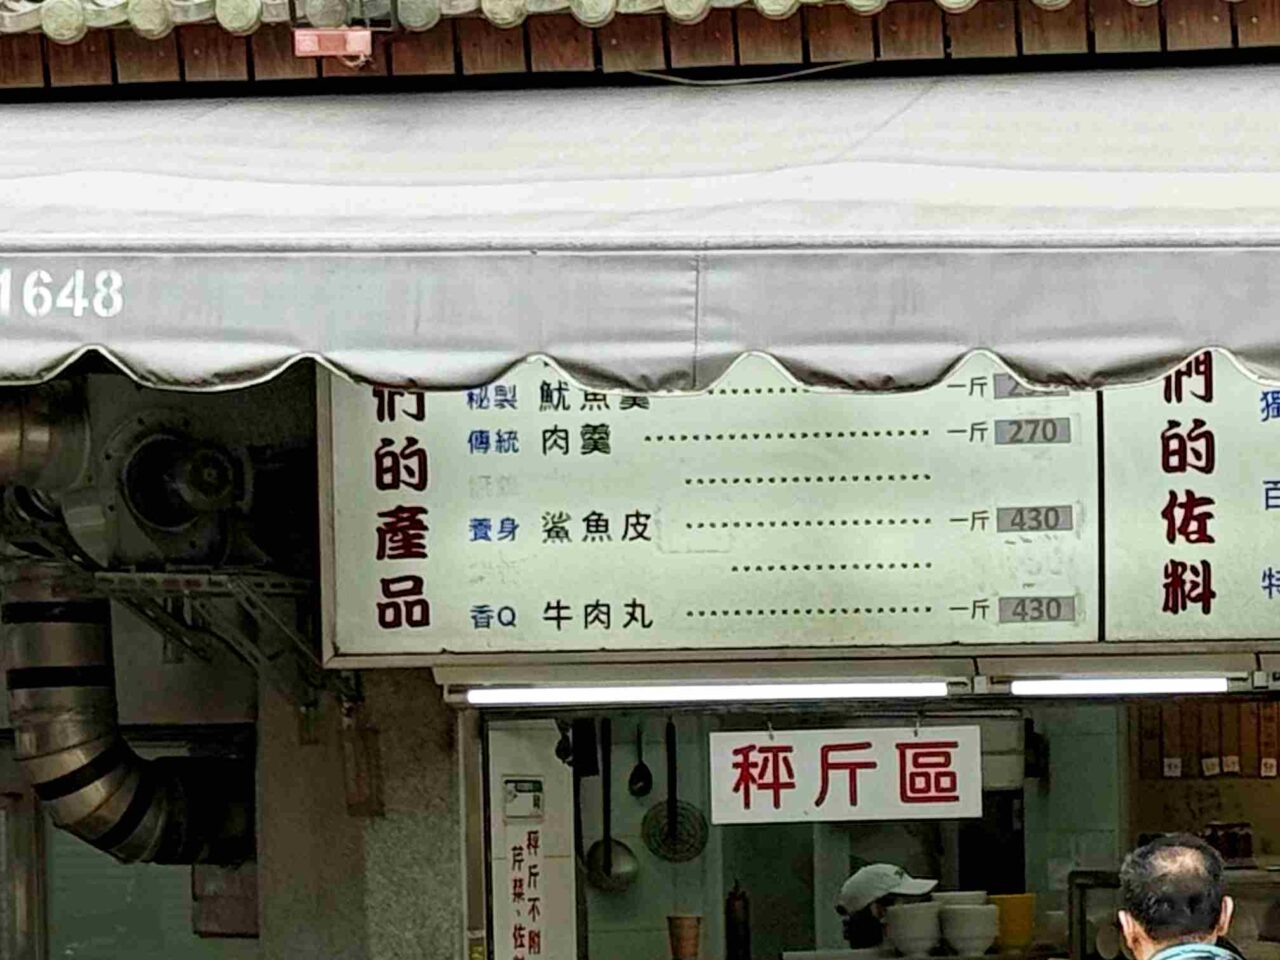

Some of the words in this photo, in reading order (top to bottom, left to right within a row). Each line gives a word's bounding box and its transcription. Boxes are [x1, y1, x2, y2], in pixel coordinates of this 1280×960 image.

[947, 376, 988, 397] 一斤
[467, 429, 519, 455] 傳統
[541, 423, 612, 456] 肉羹
[947, 421, 989, 443] 一斤
[1008, 420, 1058, 444] 270
[1161, 349, 1217, 615] 們的佐料
[372, 384, 431, 629] 們的產品
[468, 517, 520, 542] 養身
[541, 509, 652, 544] 鯊魚皮
[949, 510, 990, 531] 一斤
[1010, 507, 1060, 531] 430
[470, 605, 516, 630] 香Q
[543, 598, 653, 632] 牛肉丸
[949, 598, 990, 620] 一斤
[1011, 597, 1062, 621] 430
[732, 741, 960, 809] 秤斤區
